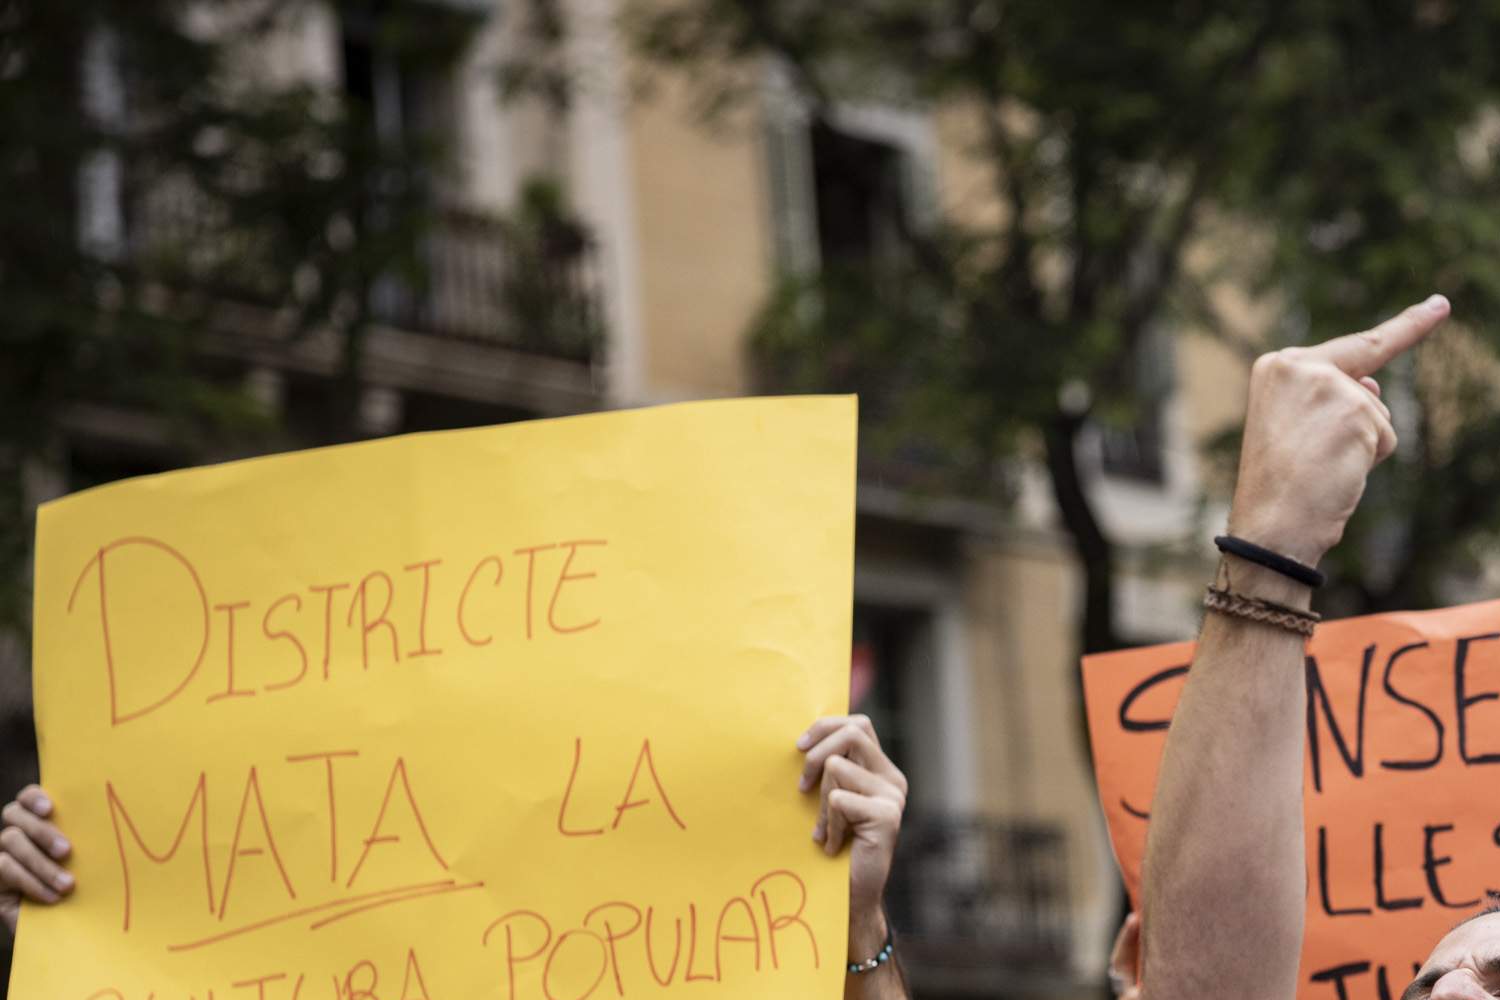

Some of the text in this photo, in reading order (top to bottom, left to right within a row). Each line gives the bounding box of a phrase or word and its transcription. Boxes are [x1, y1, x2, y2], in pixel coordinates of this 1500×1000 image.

[66, 535, 609, 727] DISTRICTE
[105, 736, 686, 933] MATA LA
